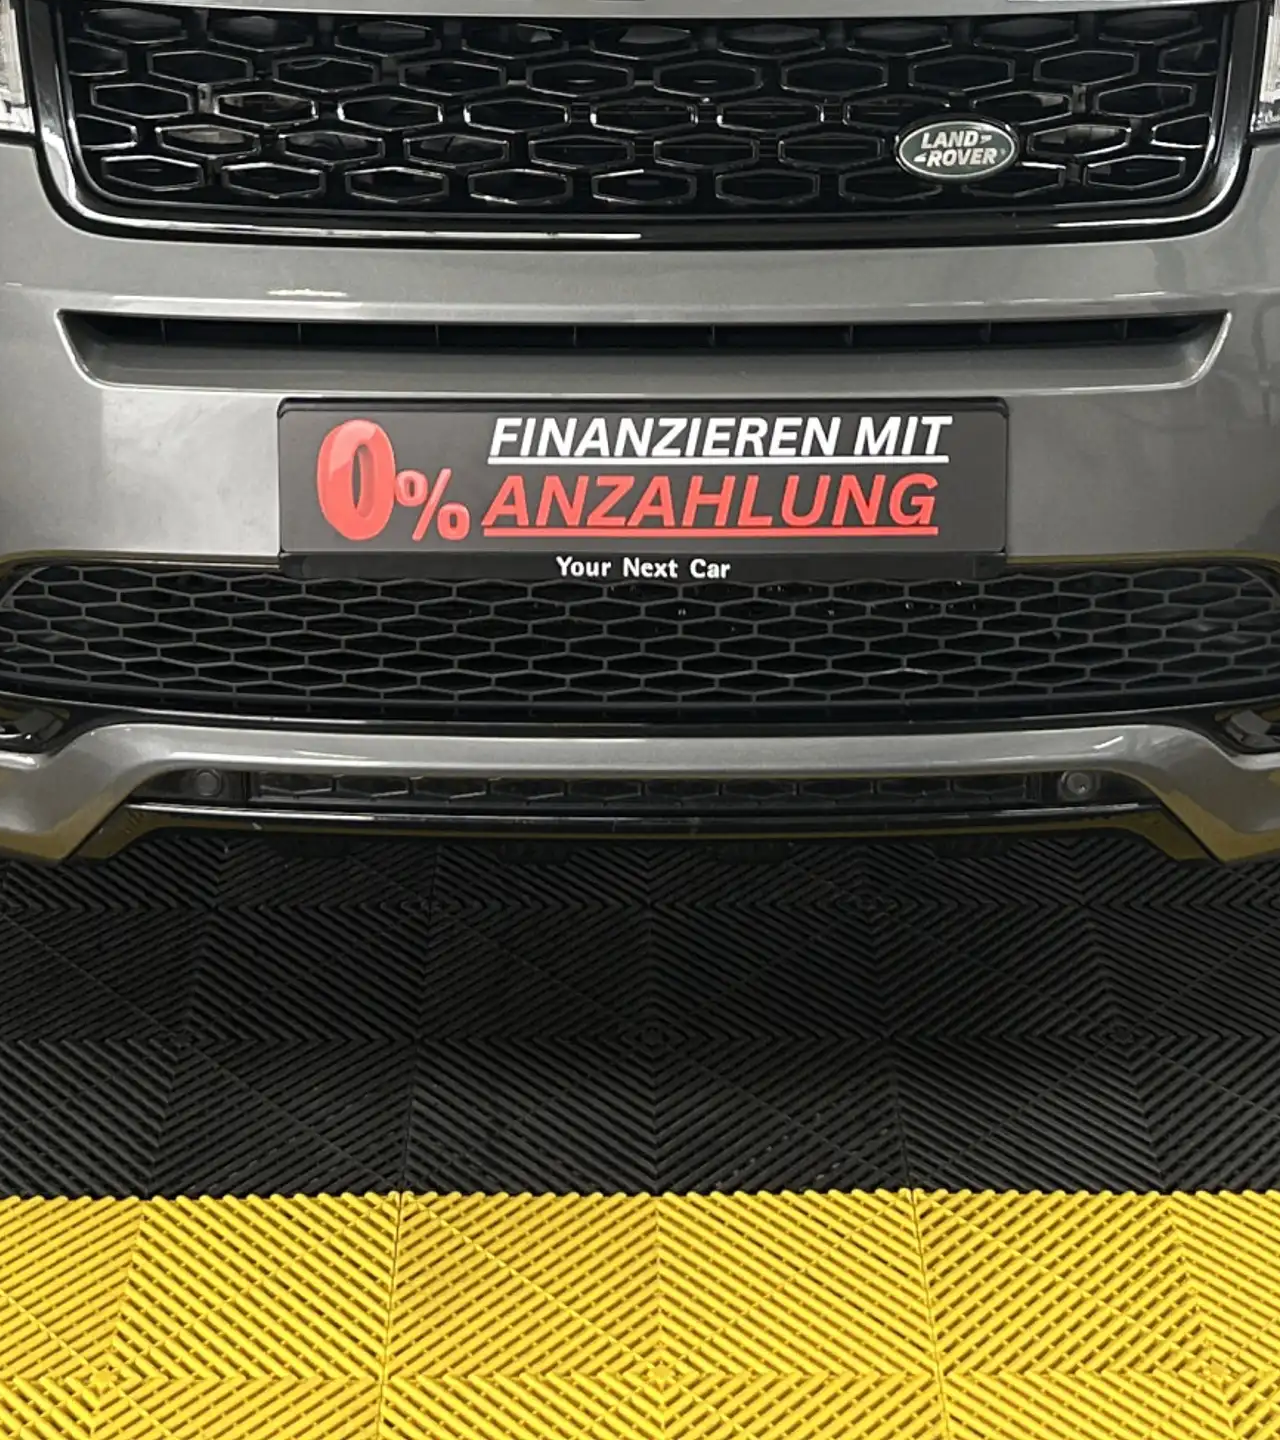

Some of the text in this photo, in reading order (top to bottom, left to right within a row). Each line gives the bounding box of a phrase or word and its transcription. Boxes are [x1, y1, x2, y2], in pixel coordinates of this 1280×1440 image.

[921, 131, 978, 149] LAND
[927, 148, 997, 167] ROVER
[488, 415, 953, 458] FINANZIEREN MIT
[317, 419, 470, 541] 0%
[482, 473, 938, 528] ANZAHLUNG
[556, 556, 731, 580] Your Next Car
